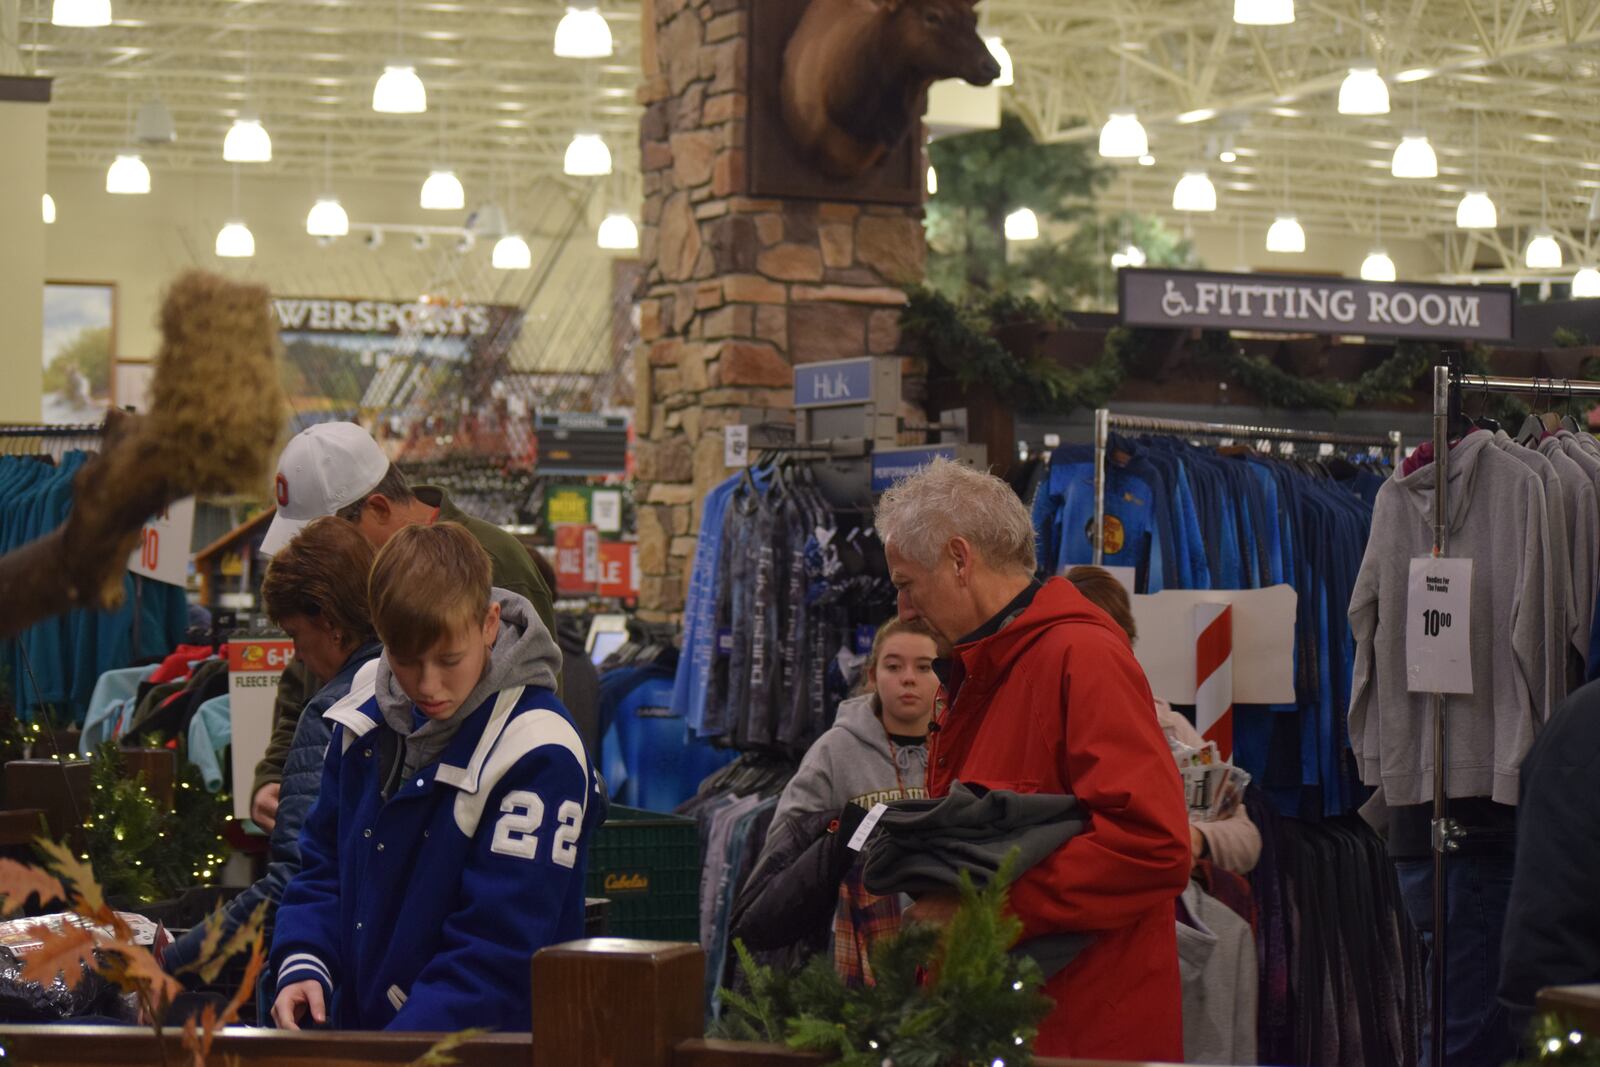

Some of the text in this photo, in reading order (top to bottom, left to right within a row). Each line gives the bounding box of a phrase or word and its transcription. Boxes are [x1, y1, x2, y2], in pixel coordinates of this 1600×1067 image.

[274, 299, 490, 334] WERSPORTS
[1195, 282, 1480, 327] FITTING ROOM
[235, 675, 268, 688] FLEECE
[490, 789, 584, 869] 22
